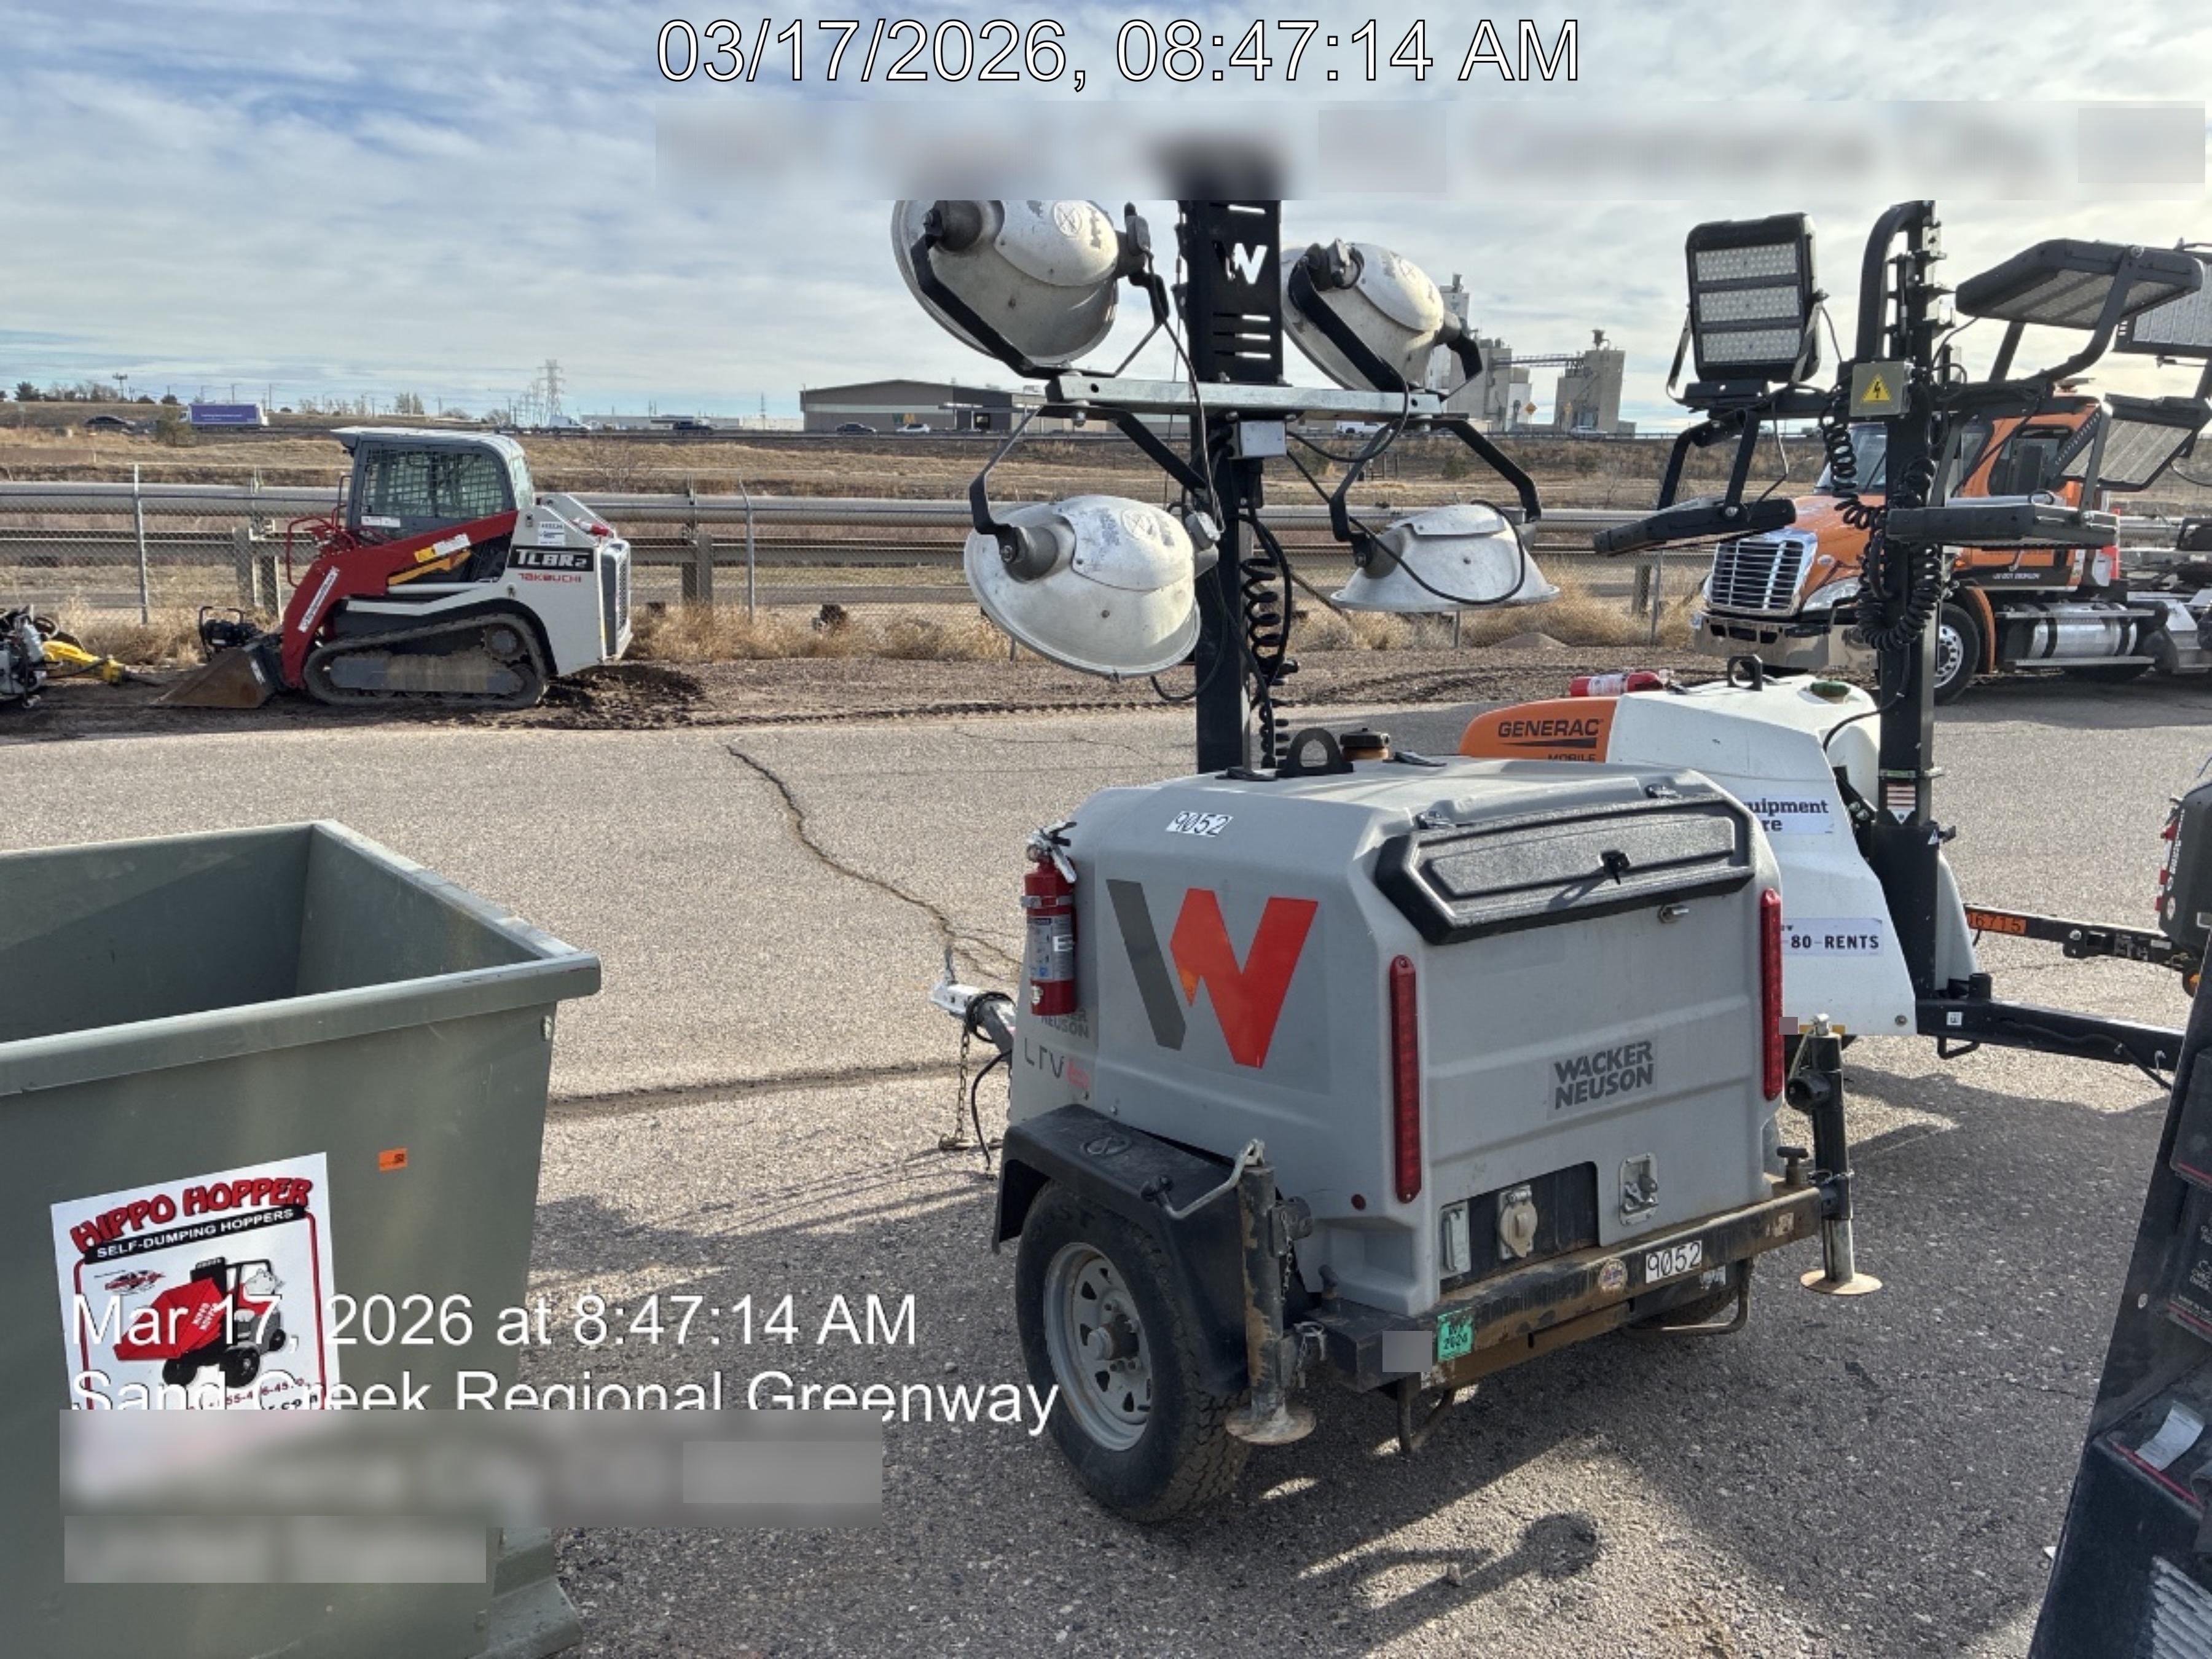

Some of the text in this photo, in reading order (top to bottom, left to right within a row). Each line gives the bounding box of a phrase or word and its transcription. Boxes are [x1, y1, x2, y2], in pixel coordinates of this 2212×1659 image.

[1498, 719, 1599, 737] GENERAC
[1175, 812, 1228, 834] 9052
[1762, 820, 1783, 831] re
[1783, 935, 1879, 949] -80-RENTS
[1554, 1040, 1653, 1084] WACKER
[1555, 1063, 1653, 1110] NEUSON
[70, 1178, 312, 1253] HIPPO HOPPER
[96, 1209, 294, 1258] SELF-DUMPING HOPPERS
[1647, 1242, 1701, 1278] 9052
